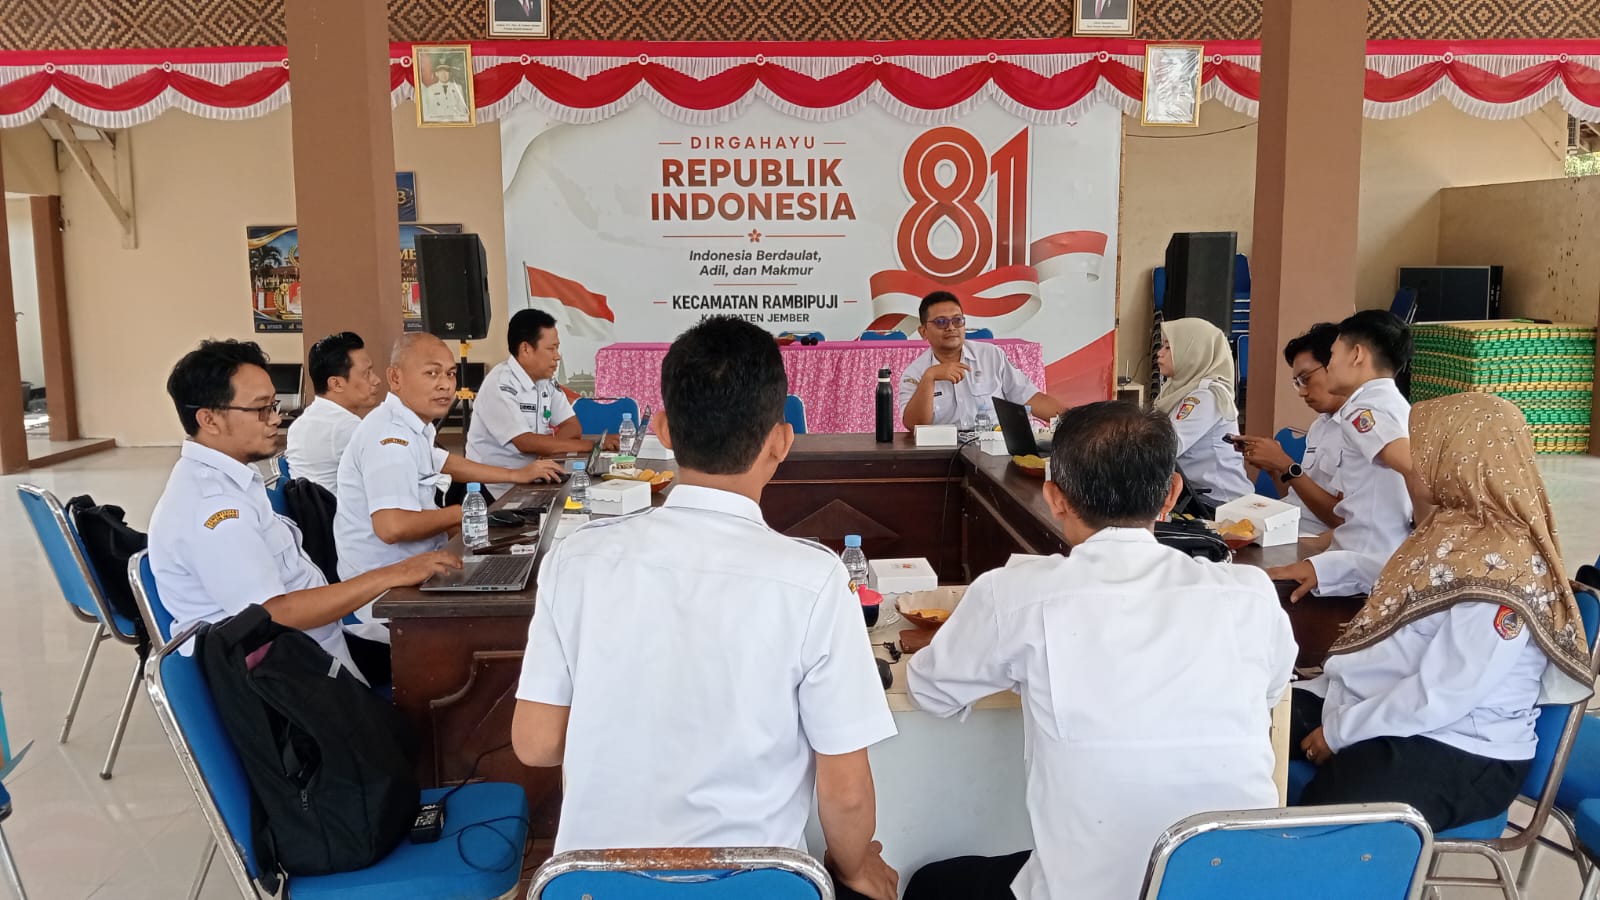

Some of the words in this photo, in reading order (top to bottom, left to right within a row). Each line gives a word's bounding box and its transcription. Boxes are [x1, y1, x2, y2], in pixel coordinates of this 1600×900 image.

[691, 136, 815, 149] DIRGAHAYU
[662, 158, 843, 187] REPUBLIK
[651, 192, 857, 221] INDONESIA
[897, 126, 1029, 286] 81
[689, 250, 752, 261] Indonesia
[756, 250, 822, 263] Berdaulat,
[699, 265, 729, 278] Adil,
[733, 265, 757, 276] dan
[761, 265, 813, 276] Makmur
[672, 295, 758, 309] KECAMATAN
[762, 294, 838, 309] RAMBIPUJI
[767, 313, 810, 323] JEMBER
